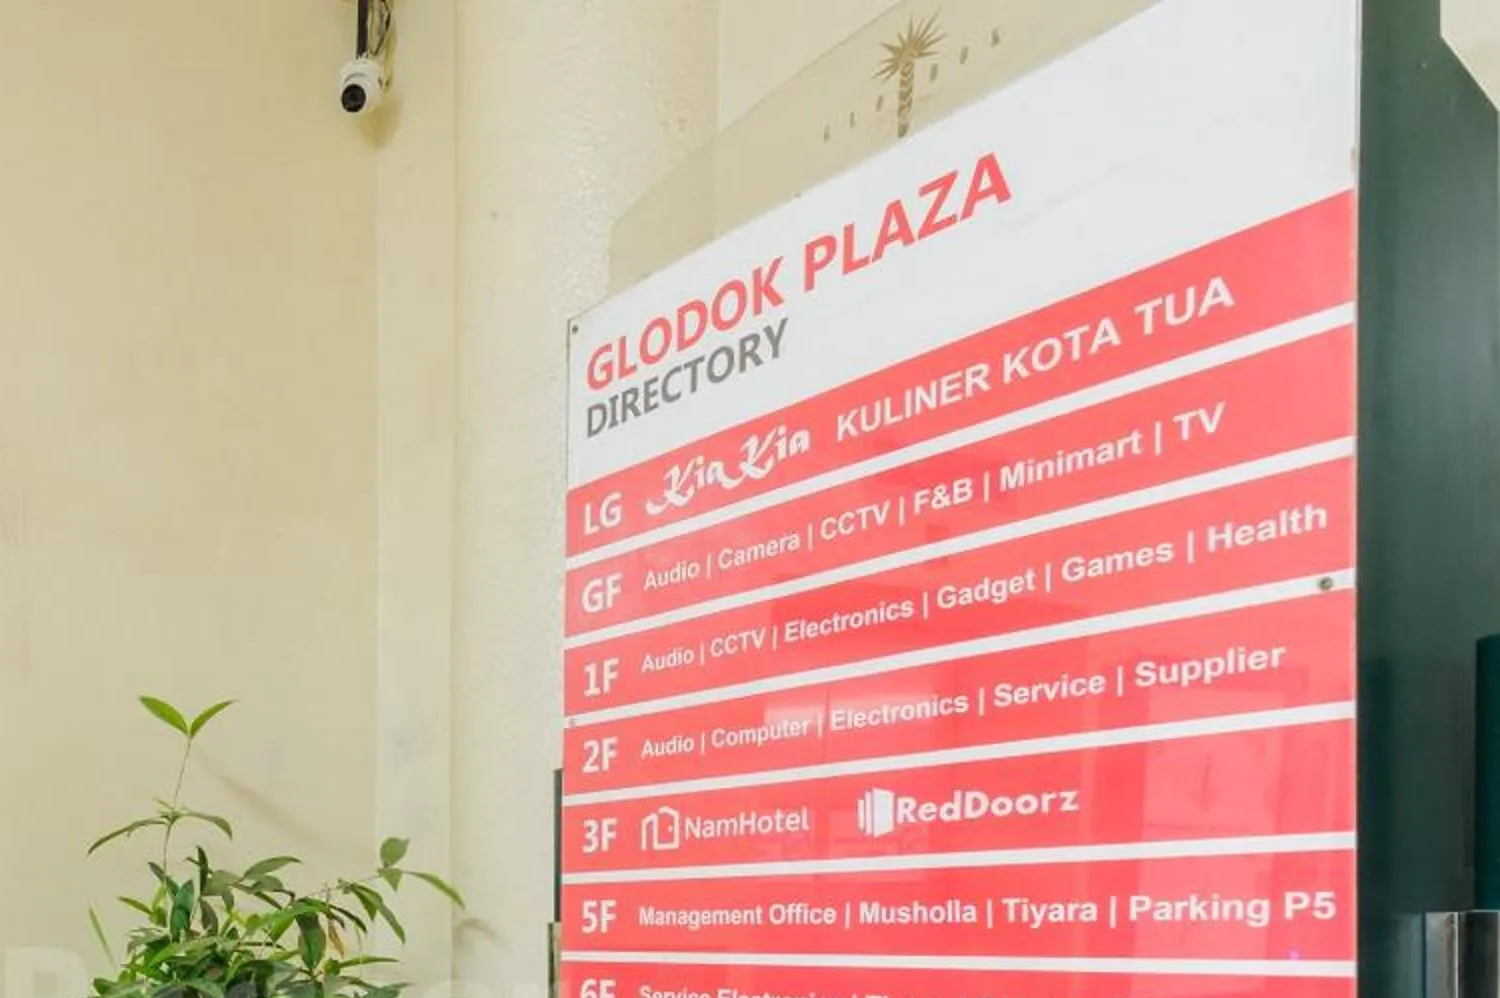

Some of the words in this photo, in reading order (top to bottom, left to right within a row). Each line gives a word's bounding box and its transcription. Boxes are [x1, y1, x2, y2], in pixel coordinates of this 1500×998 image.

[586, 256, 785, 391] GLODOK
[803, 151, 1012, 293] PLAZA
[584, 492, 623, 535] LG
[644, 455, 743, 516] Kia
[739, 424, 811, 490] Kia
[837, 364, 991, 442] KULINER
[1003, 317, 1121, 384] KOTA
[1134, 279, 1235, 335] TUA
[586, 317, 789, 438] DIRECTORY
[580, 571, 623, 614] GF
[643, 559, 701, 591] Audio
[717, 533, 801, 570] Camera
[820, 500, 891, 540] CCTV
[914, 478, 973, 515] F&B
[1000, 430, 1143, 491] Minimart
[1173, 402, 1225, 441] TV
[583, 657, 619, 697] 1F
[641, 644, 695, 674] Audio
[710, 628, 767, 657] CCTV
[784, 600, 914, 642] Electronics
[937, 568, 1036, 609] Gadget
[1061, 541, 1175, 582] Games
[1207, 503, 1328, 553] Health
[582, 736, 618, 773] 2F
[641, 733, 695, 758] Audio
[711, 715, 811, 750] Computer
[830, 692, 969, 732] Electronics
[994, 674, 1106, 707] Service
[1135, 645, 1286, 688] Supplier
[582, 818, 618, 853] 3F
[684, 807, 810, 840] NamHotel
[896, 788, 1079, 825] RedDoorz
[582, 899, 617, 933] 5F
[639, 904, 763, 929] Management
[769, 902, 837, 925] Office
[859, 899, 977, 925] Musholla
[1002, 896, 1098, 930] Tiyara
[1129, 893, 1271, 929] Parking
[1284, 890, 1336, 920] P5
